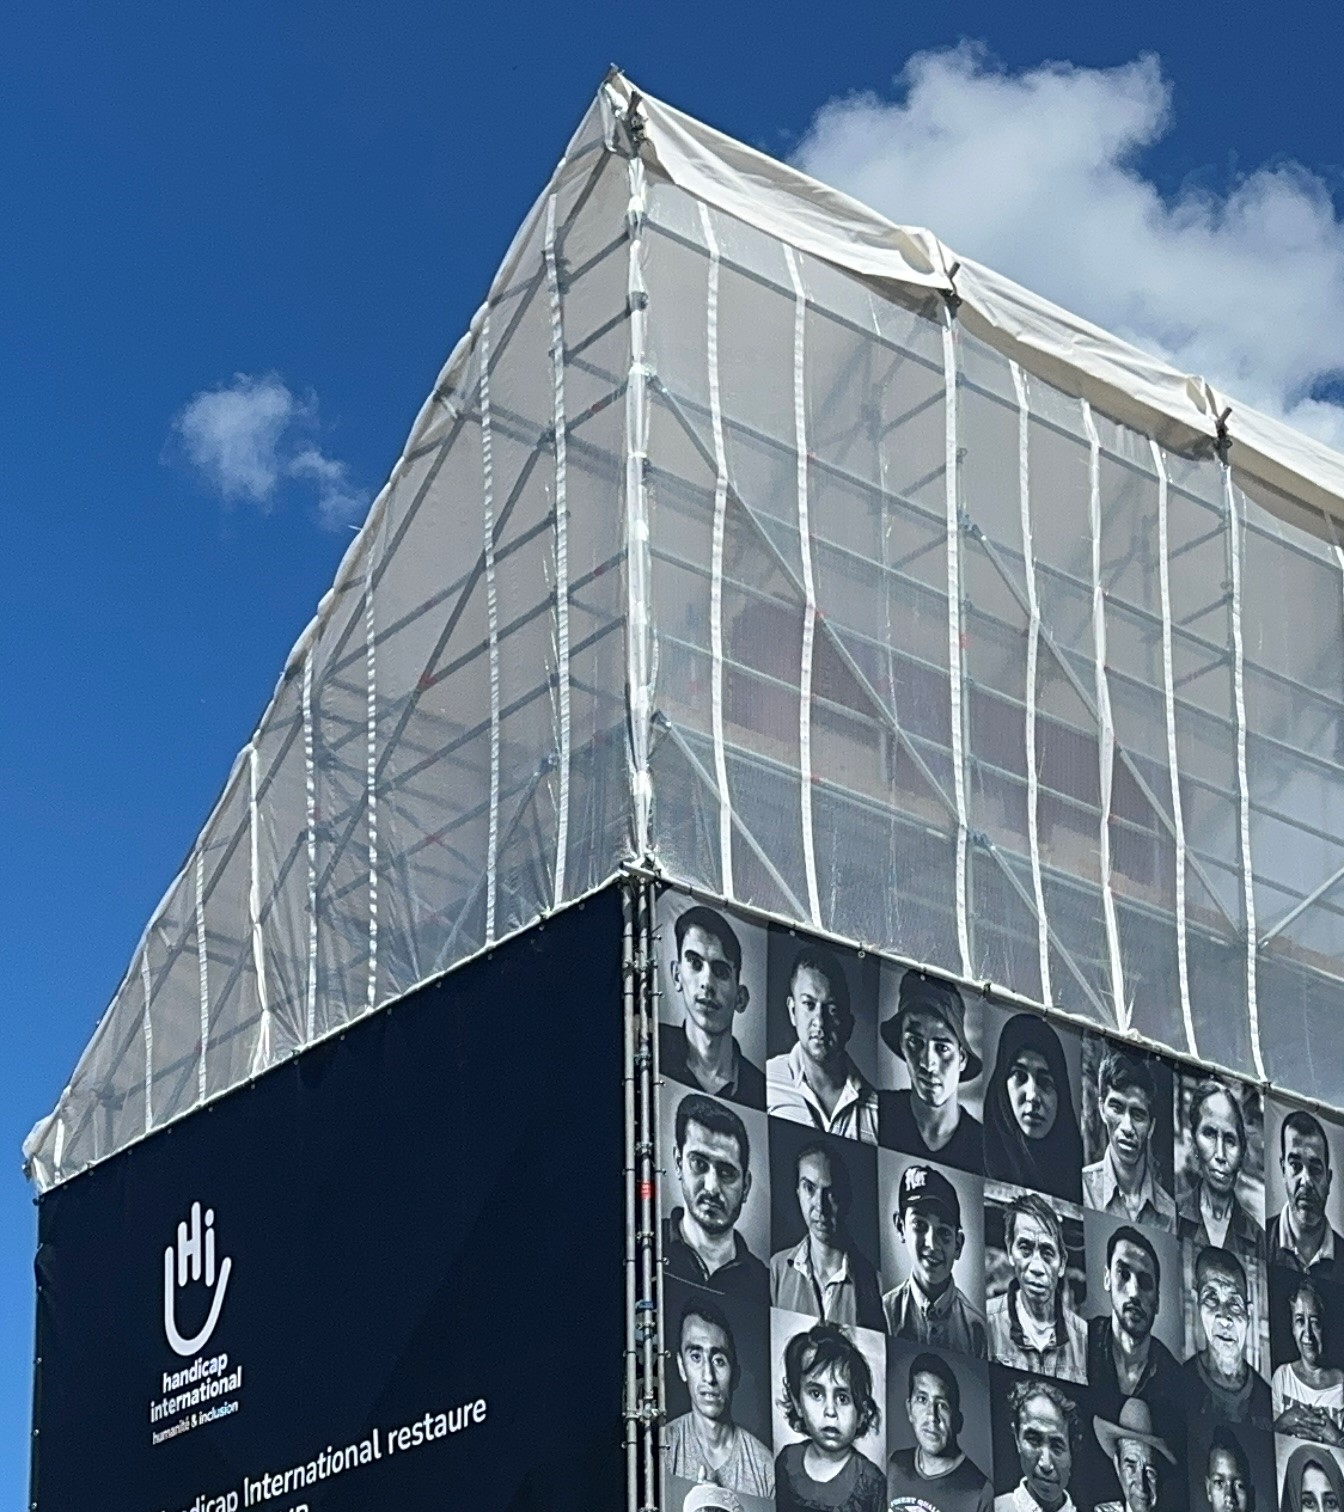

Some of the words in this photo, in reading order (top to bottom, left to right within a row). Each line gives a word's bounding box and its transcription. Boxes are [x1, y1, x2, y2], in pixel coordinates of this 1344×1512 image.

[150, 1366, 242, 1423] international
[163, 1353, 228, 1393] handicap
[153, 1415, 190, 1445] humanité
[191, 1415, 197, 1428] &
[199, 1401, 238, 1425] inclusion
[243, 1429, 382, 1507] International
[387, 1398, 486, 1454] restaure
